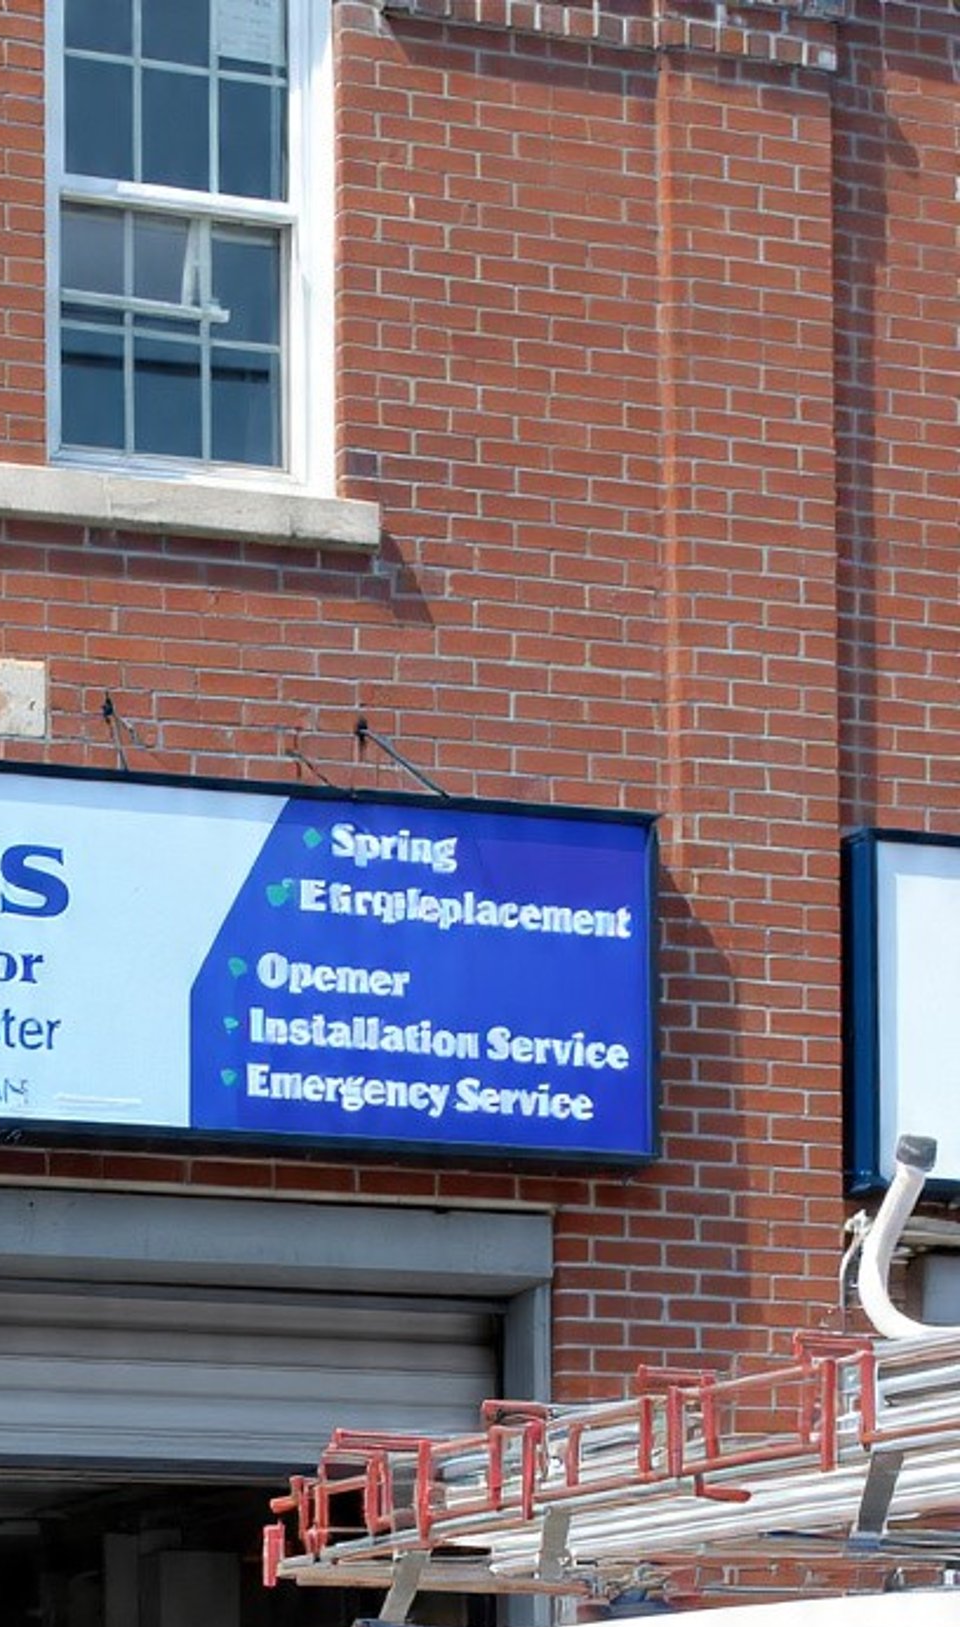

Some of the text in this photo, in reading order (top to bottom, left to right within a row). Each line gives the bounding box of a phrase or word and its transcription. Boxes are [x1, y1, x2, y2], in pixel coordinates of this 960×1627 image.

[330, 823, 459, 873] Spring
[248, 1007, 630, 1071] Installation Service
[246, 1063, 595, 1121] Emergency Service
